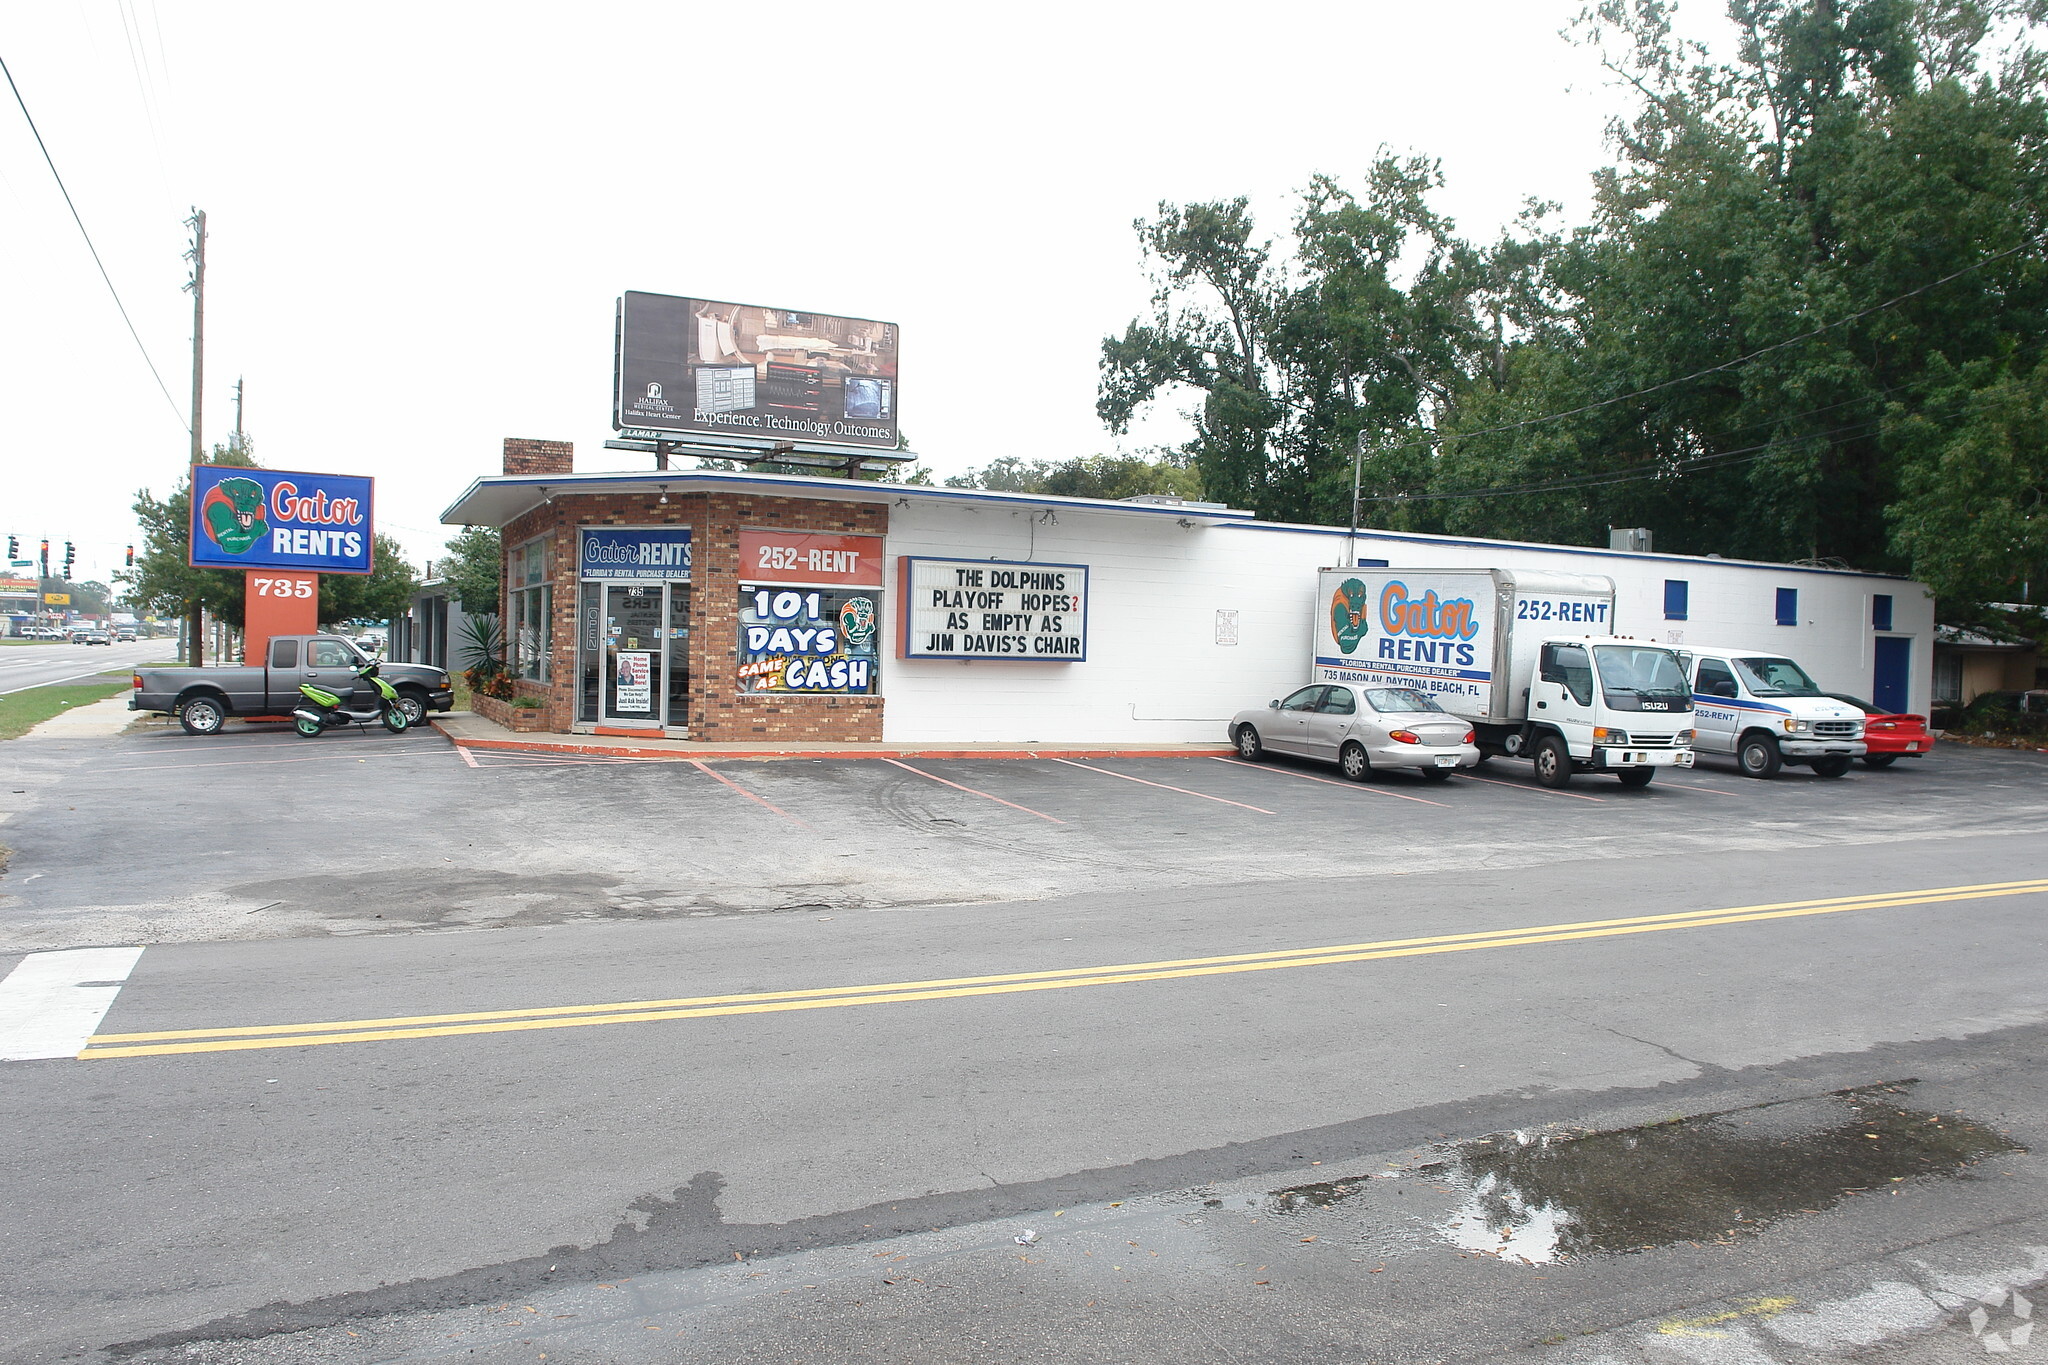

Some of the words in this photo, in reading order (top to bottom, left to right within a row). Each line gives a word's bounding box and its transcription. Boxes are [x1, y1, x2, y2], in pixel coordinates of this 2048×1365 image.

[638, 397, 669, 406] HALIFAX
[625, 409, 645, 417] Halifax
[645, 410, 661, 418] Heart
[661, 411, 682, 420] Center
[694, 407, 763, 427] Experience.
[764, 413, 832, 437] Technology.
[834, 421, 893, 439] Outcomes.
[627, 430, 658, 438] LAMAR
[271, 480, 363, 525] Gator
[272, 528, 362, 557] RENTS
[584, 537, 639, 563] Gator
[639, 542, 692, 566] RENTS
[758, 545, 860, 573] 252-RENT
[614, 569, 635, 577] RENTAL
[636, 570, 664, 578] PURCHASE
[956, 569, 983, 587] THE
[991, 570, 1065, 591] DOLPHINS
[253, 578, 313, 598] 735
[627, 586, 644, 597] 735
[754, 590, 821, 620] 101
[933, 589, 1004, 609] PLAYOFF
[1021, 593, 1079, 612] HOPES?
[1380, 580, 1479, 641] Gator
[1517, 600, 1608, 623] 252-RENT
[588, 610, 598, 648] OPEN
[947, 612, 969, 630] AS
[982, 613, 1032, 631] EMPTY
[1041, 615, 1062, 633] AS
[747, 626, 837, 655] DAYS
[925, 633, 954, 651] JIM
[963, 634, 1027, 653] DAVIS'S
[1034, 636, 1080, 654] CHAIR
[1378, 637, 1475, 666] RENTS
[738, 658, 784, 677] SAME
[785, 659, 868, 688] CASH
[1372, 662, 1396, 671] RENTAL
[1397, 664, 1431, 674] PURCHASE
[755, 676, 778, 690] AS
[1323, 670, 1338, 680] 735
[1339, 671, 1369, 682] MASON
[1386, 676, 1428, 690] DAYTONA
[1430, 682, 1465, 697] BEACH,
[1468, 685, 1480, 696] FL
[1642, 702, 1669, 711] ISUZU
[1695, 709, 1735, 721] 252-RENT
